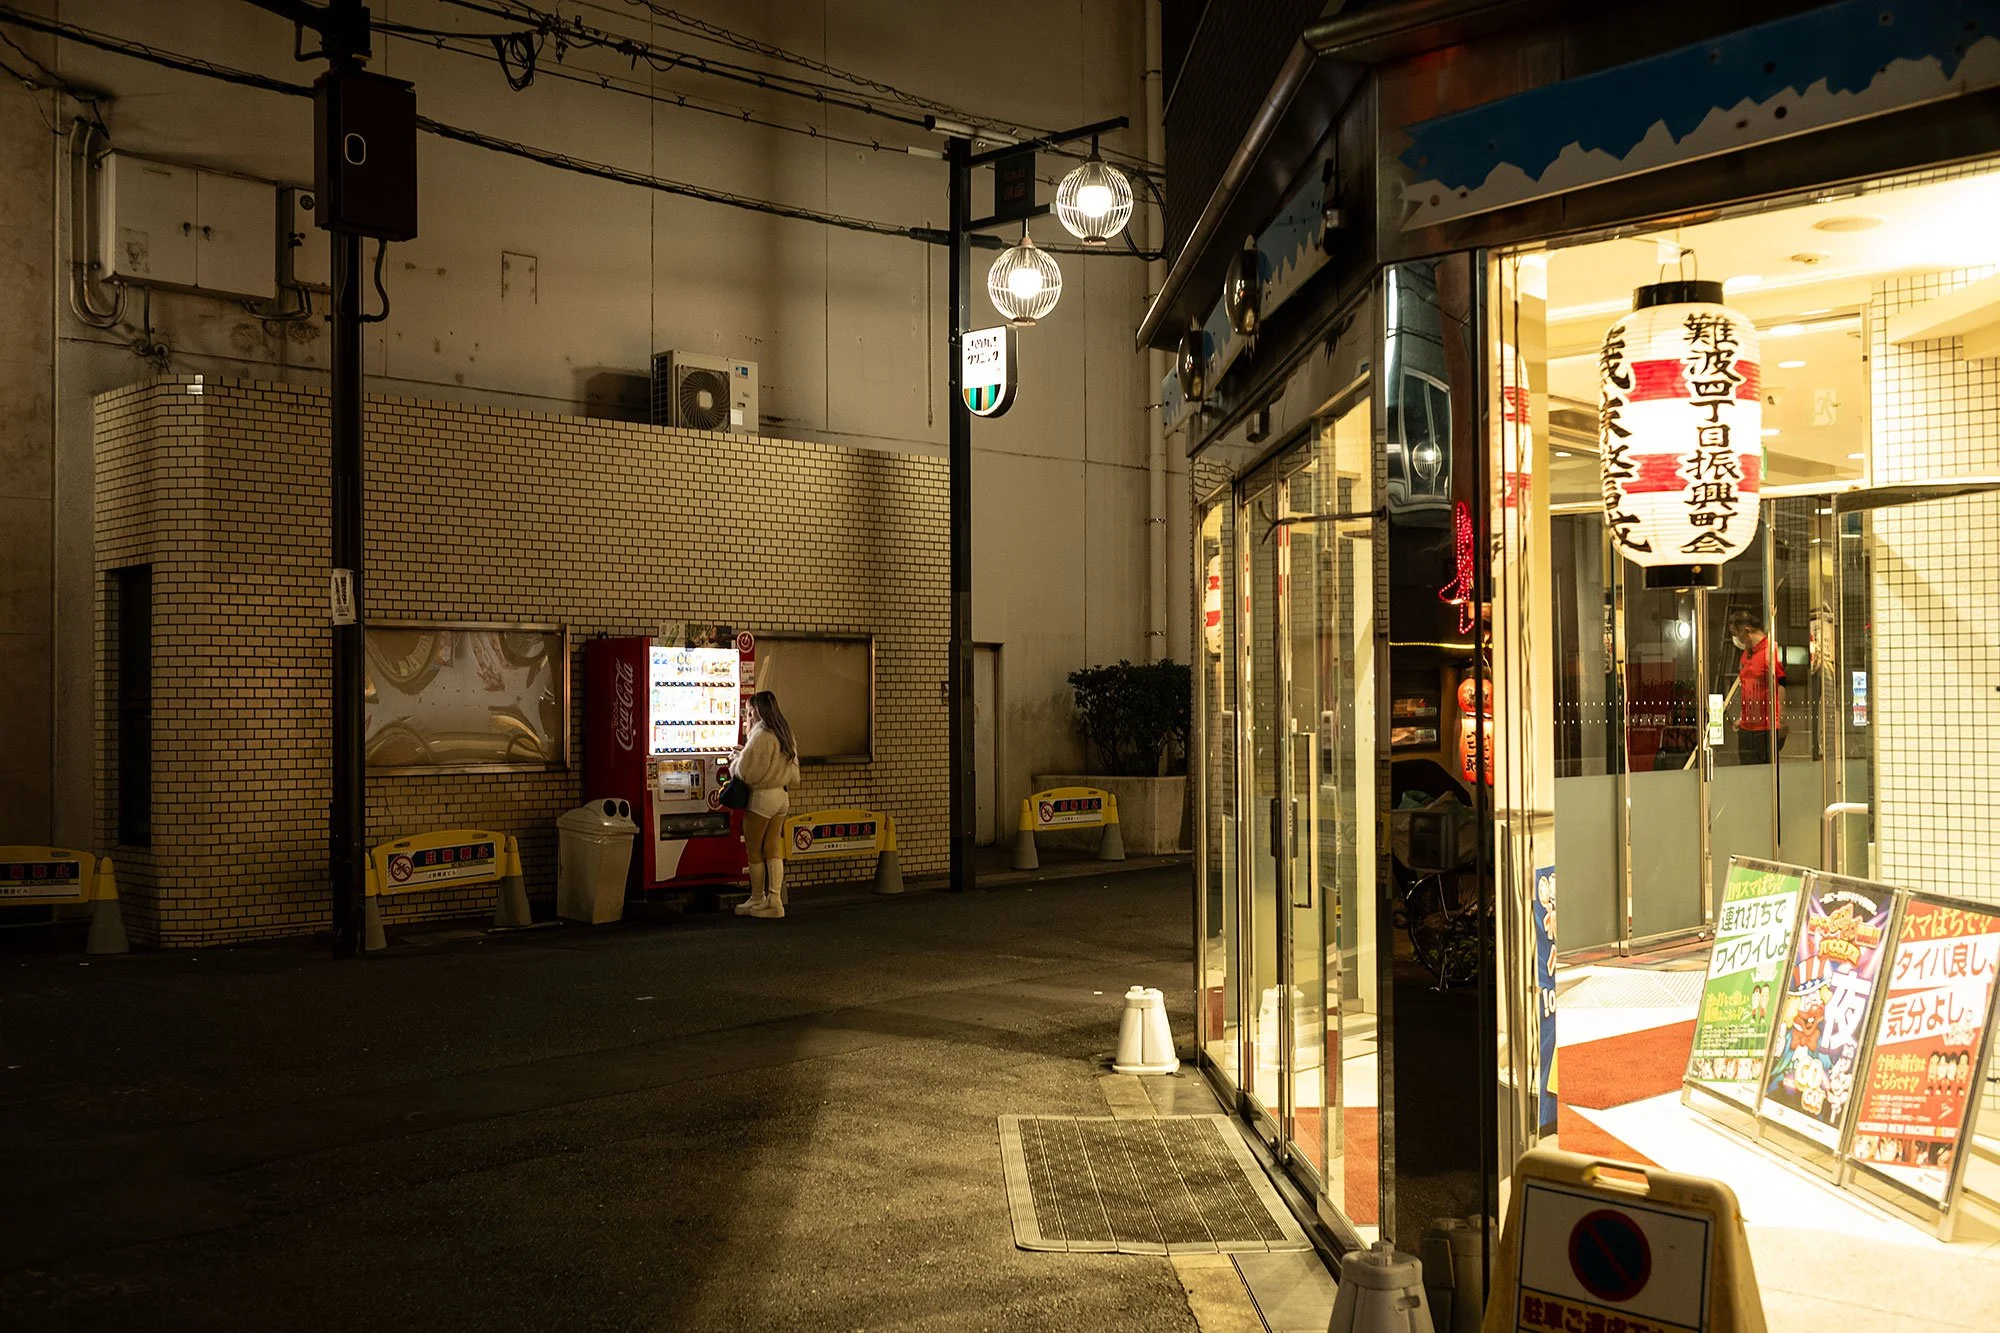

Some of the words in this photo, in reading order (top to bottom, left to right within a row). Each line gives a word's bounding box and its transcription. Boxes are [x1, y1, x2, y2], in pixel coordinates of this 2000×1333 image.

[1720, 897, 1787, 932] 連れ打ちで
[1820, 968, 1871, 1051] 夜
